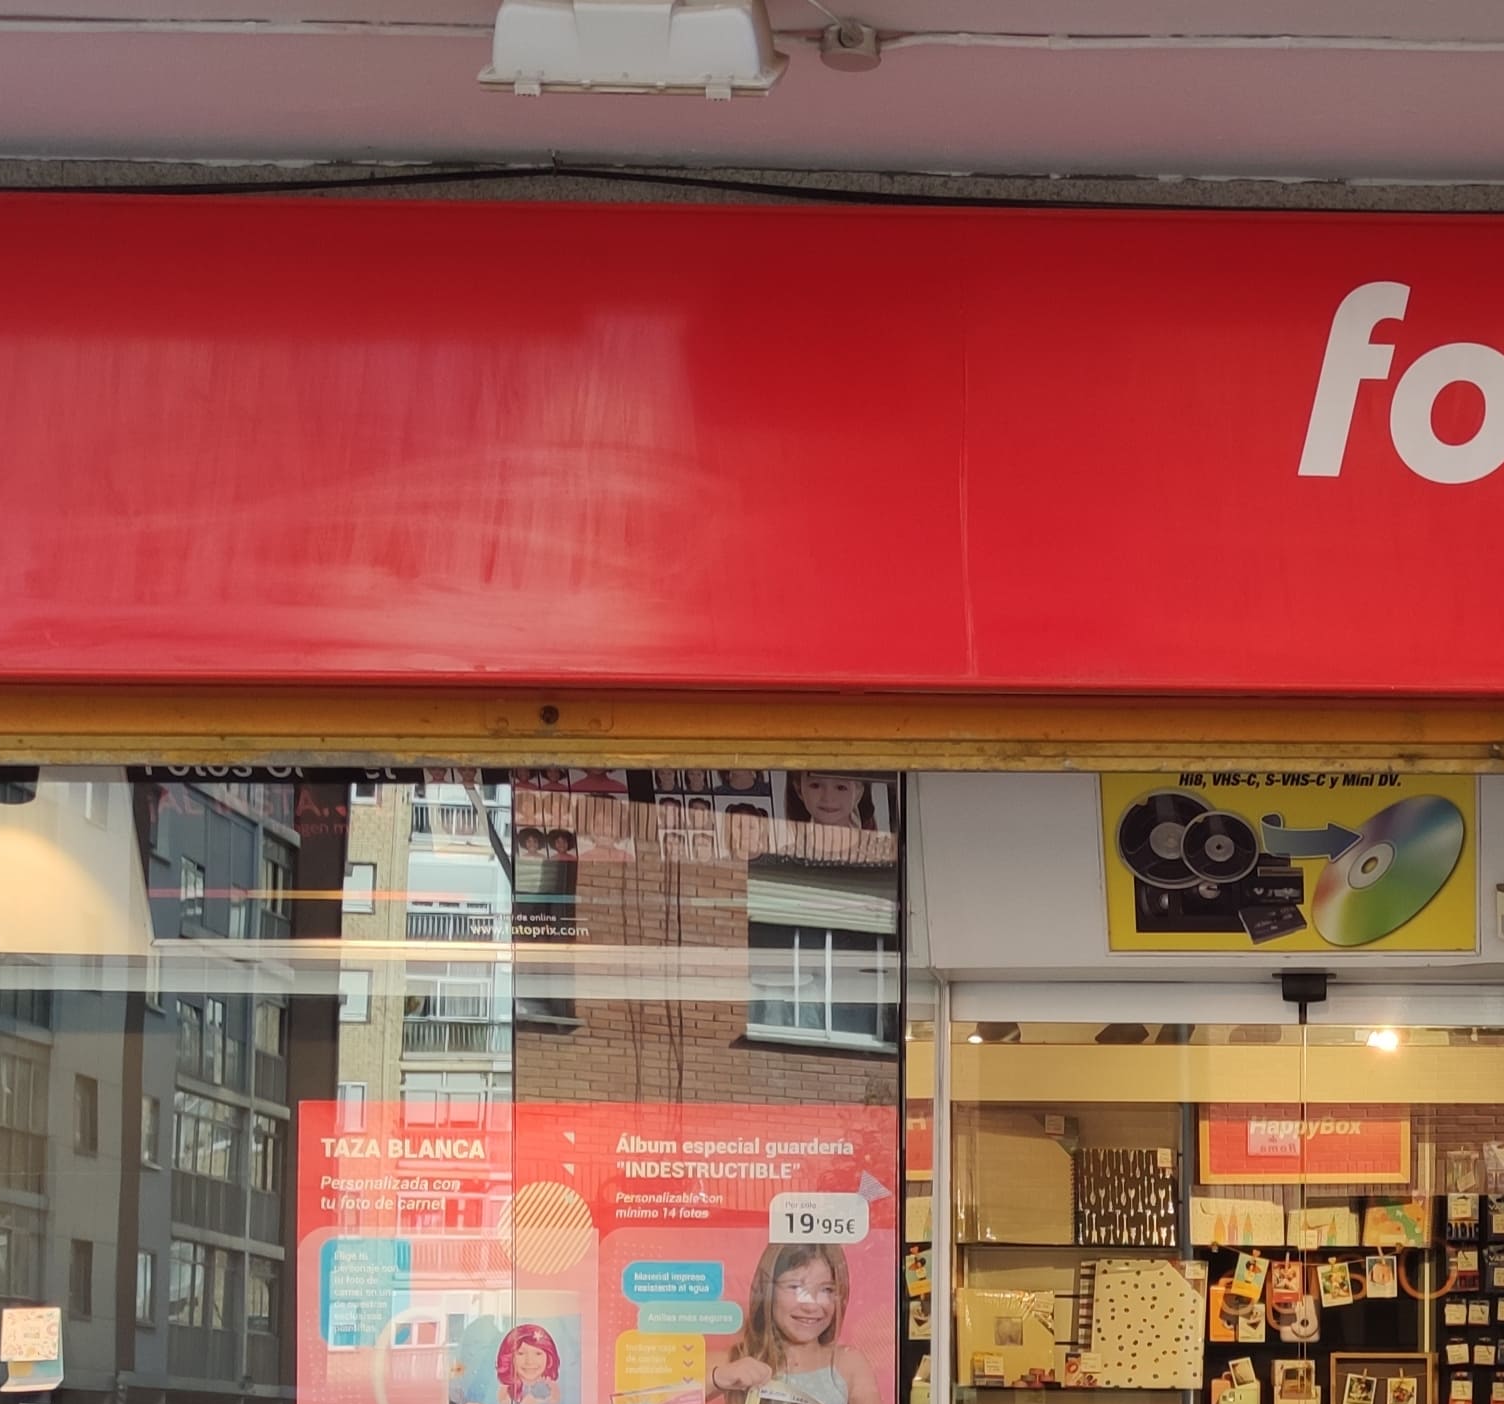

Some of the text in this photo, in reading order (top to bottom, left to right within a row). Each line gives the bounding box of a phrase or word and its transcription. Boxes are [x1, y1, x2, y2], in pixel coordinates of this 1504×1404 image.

[1178, 772, 1401, 789] Hi8, VHS-C, S-VHS-C y Mini DV.
[1249, 1116, 1361, 1139] HappyBox
[321, 1138, 486, 1159] TAZA BLANCA
[616, 1132, 854, 1158] Álbum especial guardería
[321, 1175, 462, 1192] Personalizada con
[321, 1196, 446, 1211] tu foto de carnet
[615, 1191, 723, 1204] Personalizable con
[615, 1206, 710, 1219] mínimo 14 fotos
